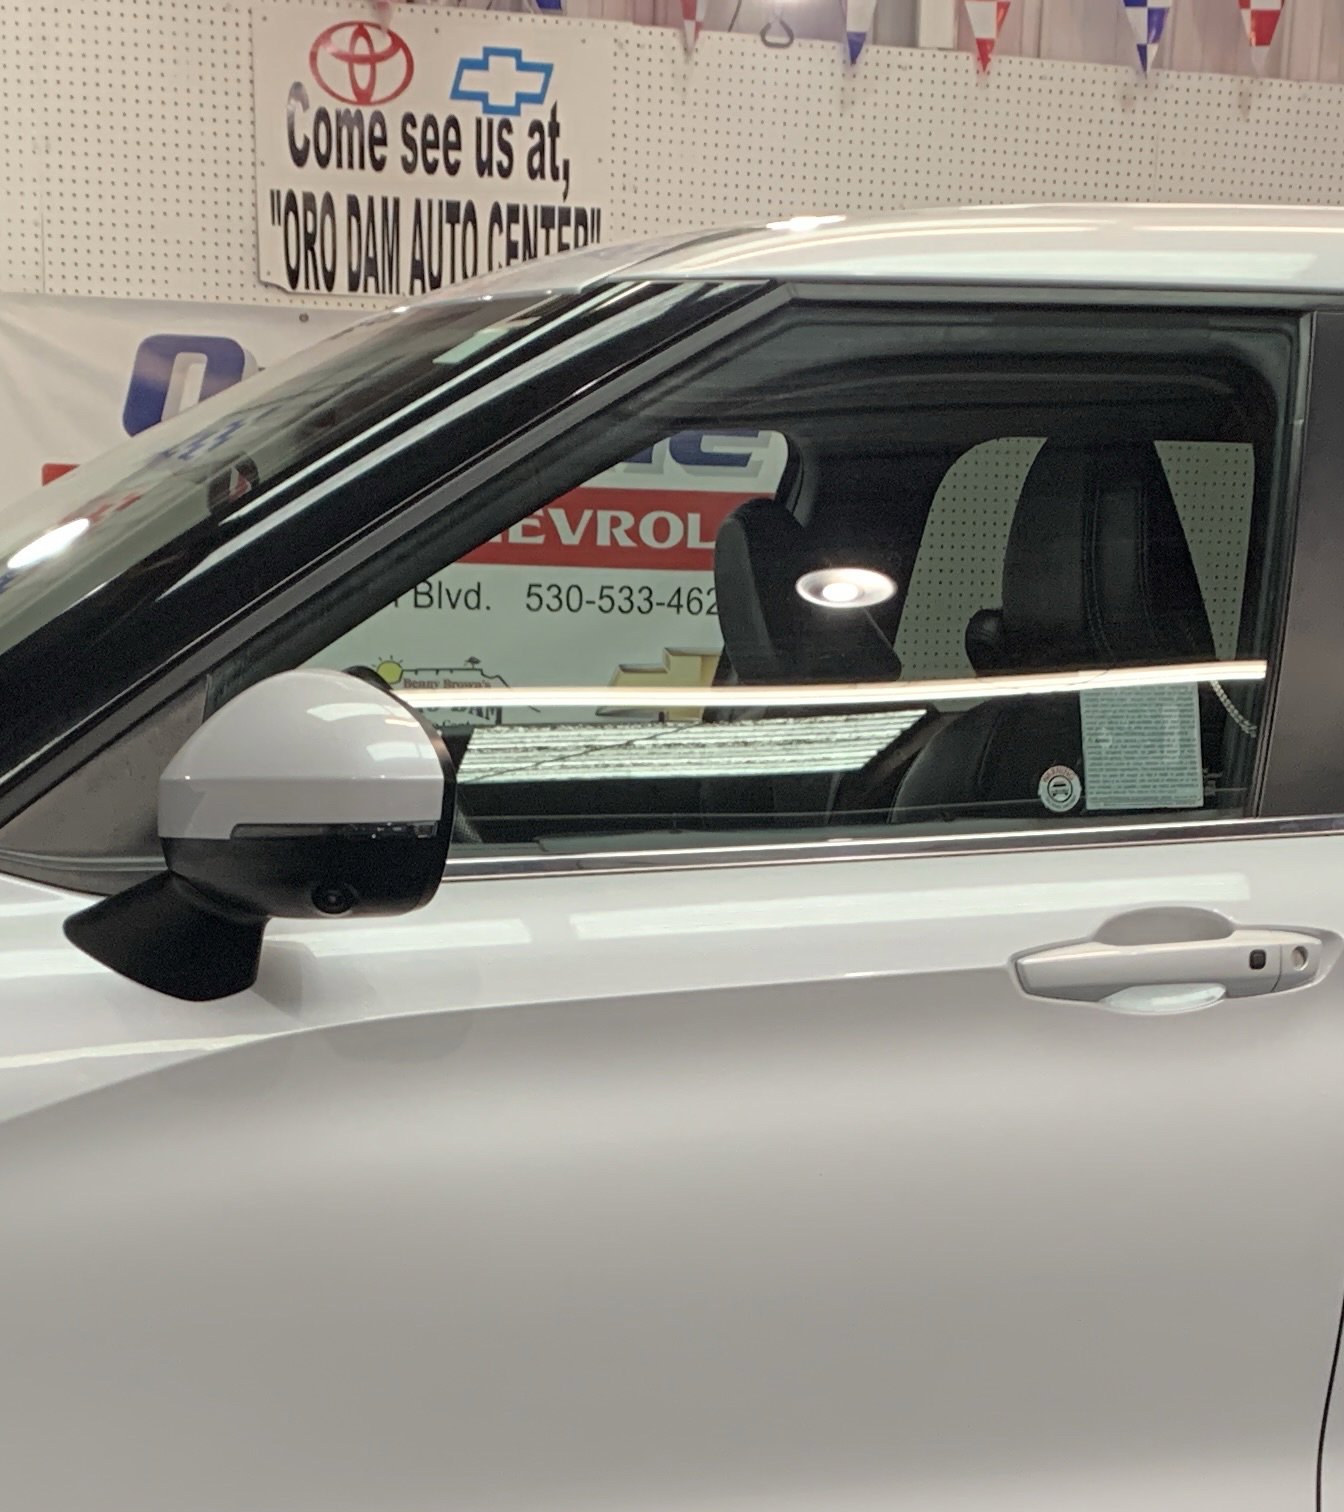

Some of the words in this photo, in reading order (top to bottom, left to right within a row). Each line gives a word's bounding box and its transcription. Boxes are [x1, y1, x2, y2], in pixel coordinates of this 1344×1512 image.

[286, 81, 388, 172] Come
[400, 111, 462, 176] see
[475, 116, 514, 180] us
[526, 101, 570, 201] at,
[269, 188, 337, 293] "ORO
[346, 193, 401, 295] DAM
[409, 197, 478, 296] AUTO
[488, 507, 715, 549] EVROL
[412, 580, 492, 612] Blvd.
[525, 582, 719, 616] 530-533-462
